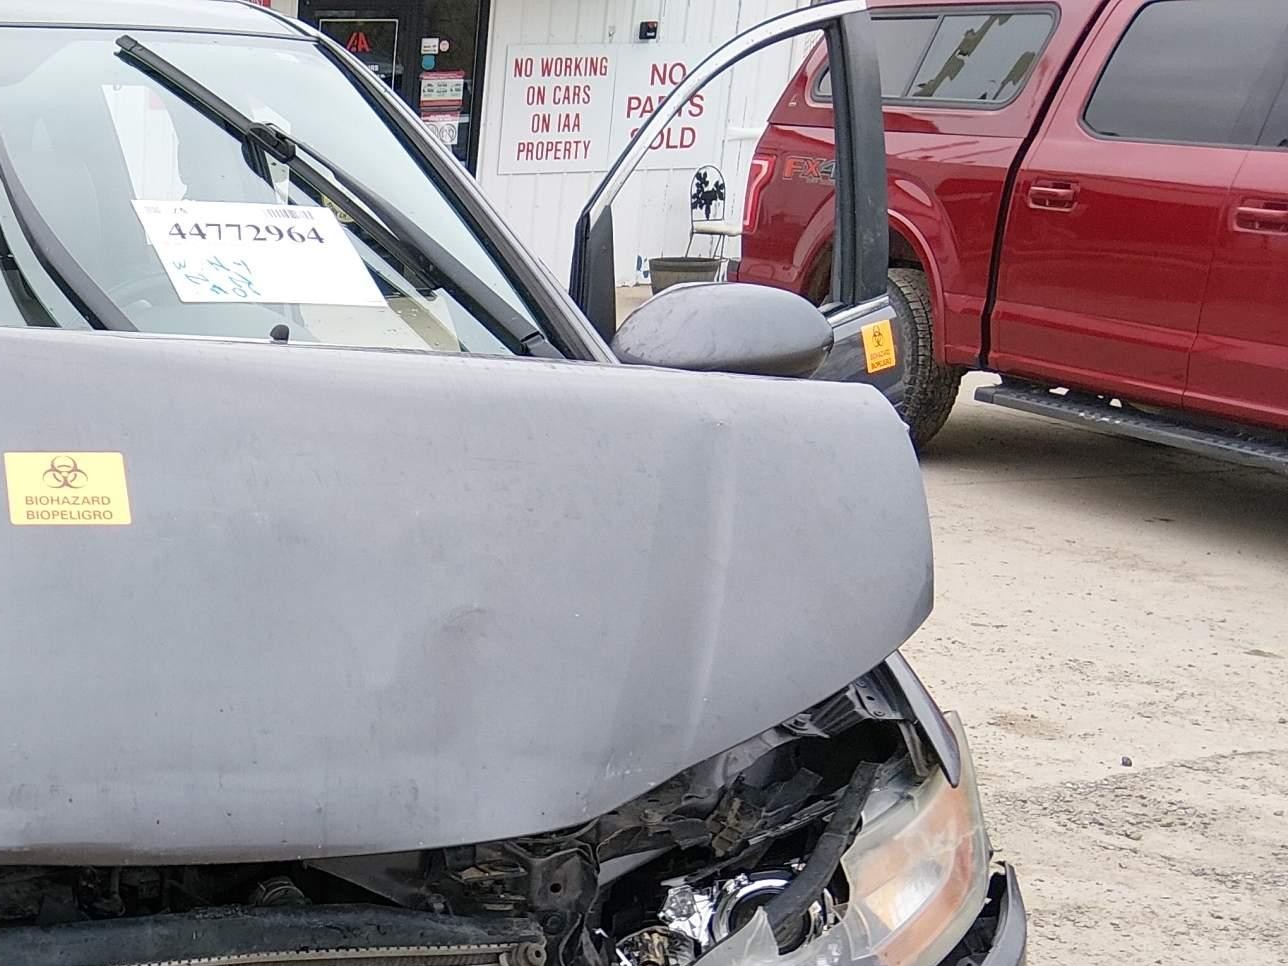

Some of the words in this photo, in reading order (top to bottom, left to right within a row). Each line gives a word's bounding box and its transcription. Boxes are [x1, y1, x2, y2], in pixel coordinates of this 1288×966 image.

[513, 57, 533, 78] NO
[541, 57, 608, 77] WORKING
[650, 63, 687, 86] NO
[527, 86, 546, 106] ON
[553, 85, 591, 105] CARS
[626, 94, 704, 119] PAS
[531, 114, 551, 133] ON
[557, 113, 580, 132] IAA
[516, 140, 591, 161] PROPERTY
[168, 222, 325, 244] 44772964
[25, 495, 111, 506] BIOHAZARD
[26, 509, 113, 521] BIOPELIGRO
